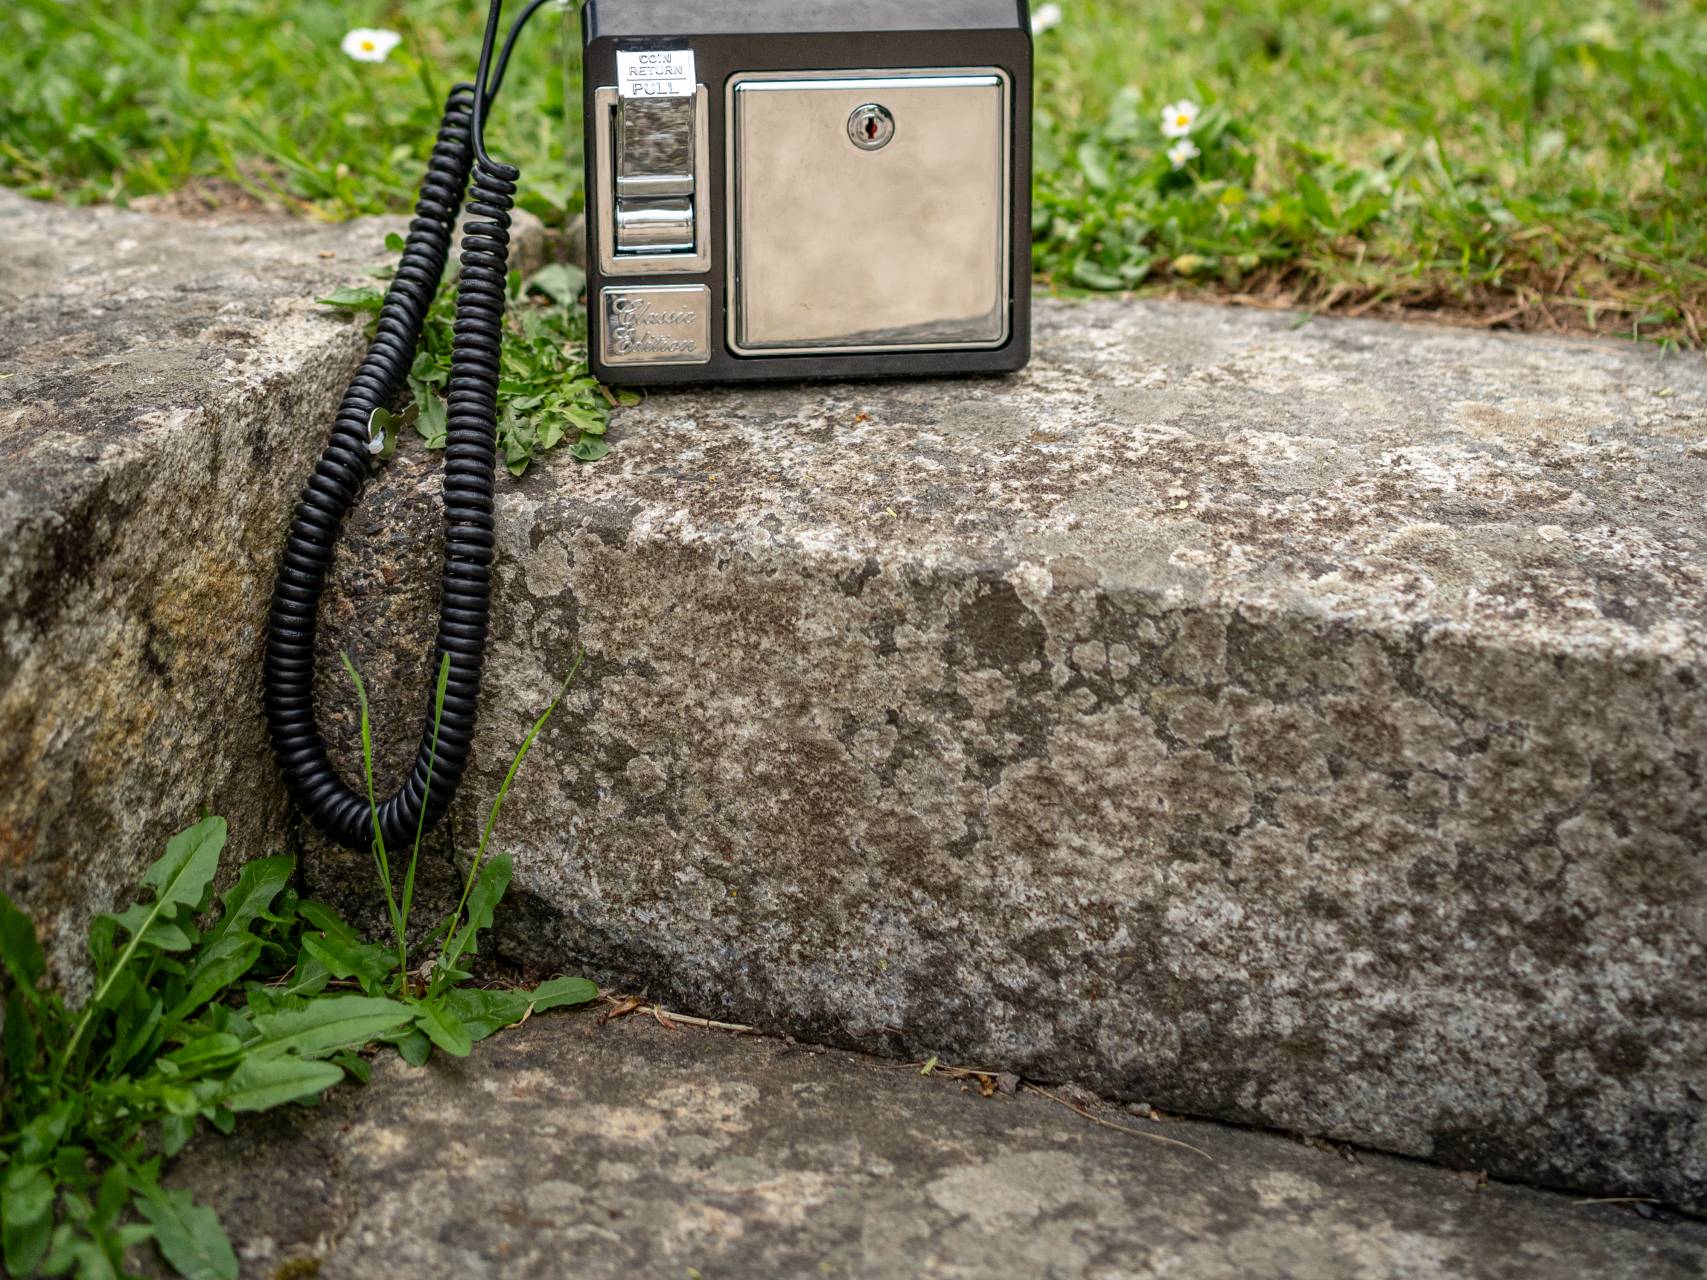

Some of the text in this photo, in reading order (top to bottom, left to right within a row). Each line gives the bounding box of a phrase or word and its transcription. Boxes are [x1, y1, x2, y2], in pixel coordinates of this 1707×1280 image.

[639, 53, 672, 64] COIN
[629, 65, 683, 76] RETURN
[632, 81, 680, 95] PULL
[612, 298, 697, 327] Classic
[613, 326, 697, 355] Edition
